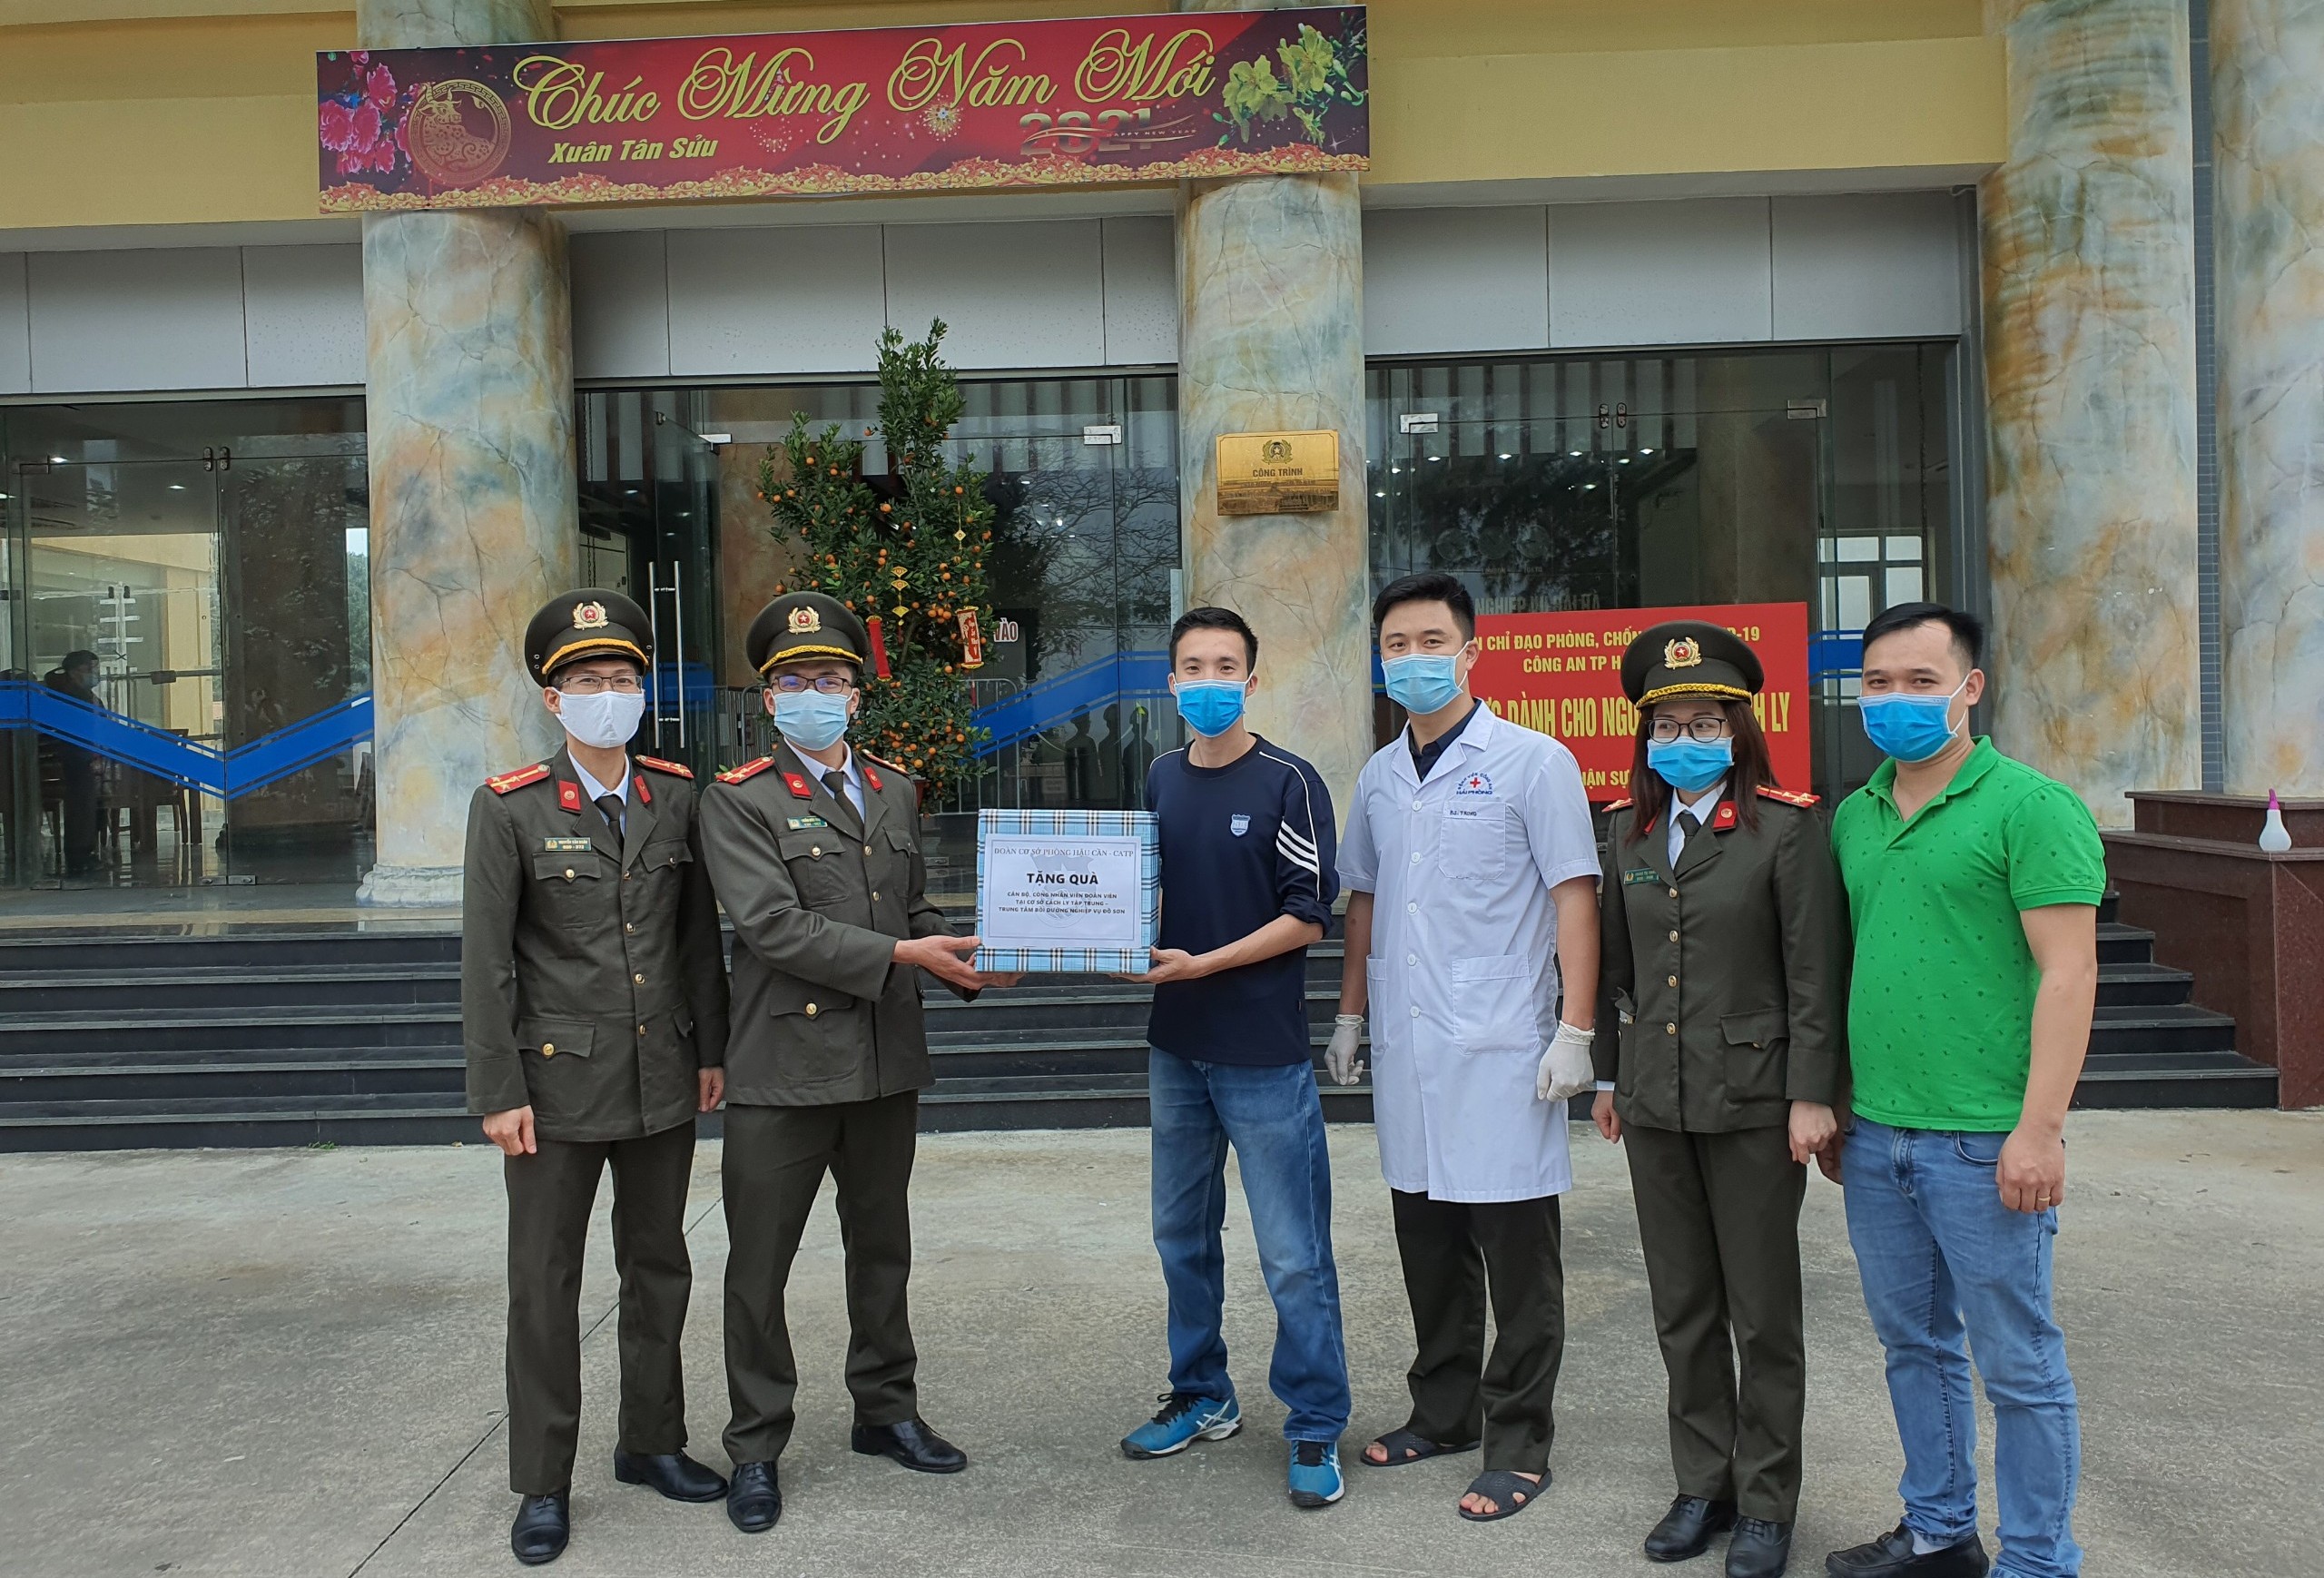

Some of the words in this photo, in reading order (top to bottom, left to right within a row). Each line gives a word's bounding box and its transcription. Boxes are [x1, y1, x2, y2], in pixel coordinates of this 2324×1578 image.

[512, 55, 662, 130] Chúc
[677, 46, 870, 144] Mừng
[887, 37, 1057, 112] Năm
[1075, 28, 1216, 103] Mới
[1019, 107, 1152, 155] 2021
[547, 142, 613, 164] Xuân
[620, 139, 664, 161] Tân
[669, 133, 719, 158] Sửu
[1252, 468, 1275, 478] CÔNG
[1278, 467, 1304, 476] TRÌNH
[1487, 631, 1510, 650] CHỈ
[1514, 634, 1542, 652] ĐẠO
[1547, 630, 1600, 648] PHÒNG,
[1603, 626, 1641, 646] CHỐ
[1523, 655, 1561, 673] CÔNG
[1566, 656, 1586, 671] AN
[1590, 656, 1607, 671] TP
[1507, 691, 1555, 737] DÀNH
[1561, 697, 1597, 738] CHO
[1601, 696, 1641, 736] NGƯ
[1771, 692, 1790, 733] LY
[1610, 769, 1630, 789] SỰ
[1043, 847, 1071, 856] PHÒNG
[1027, 870, 1066, 886] TẶNG
[1069, 872, 1099, 886] QUÀ
